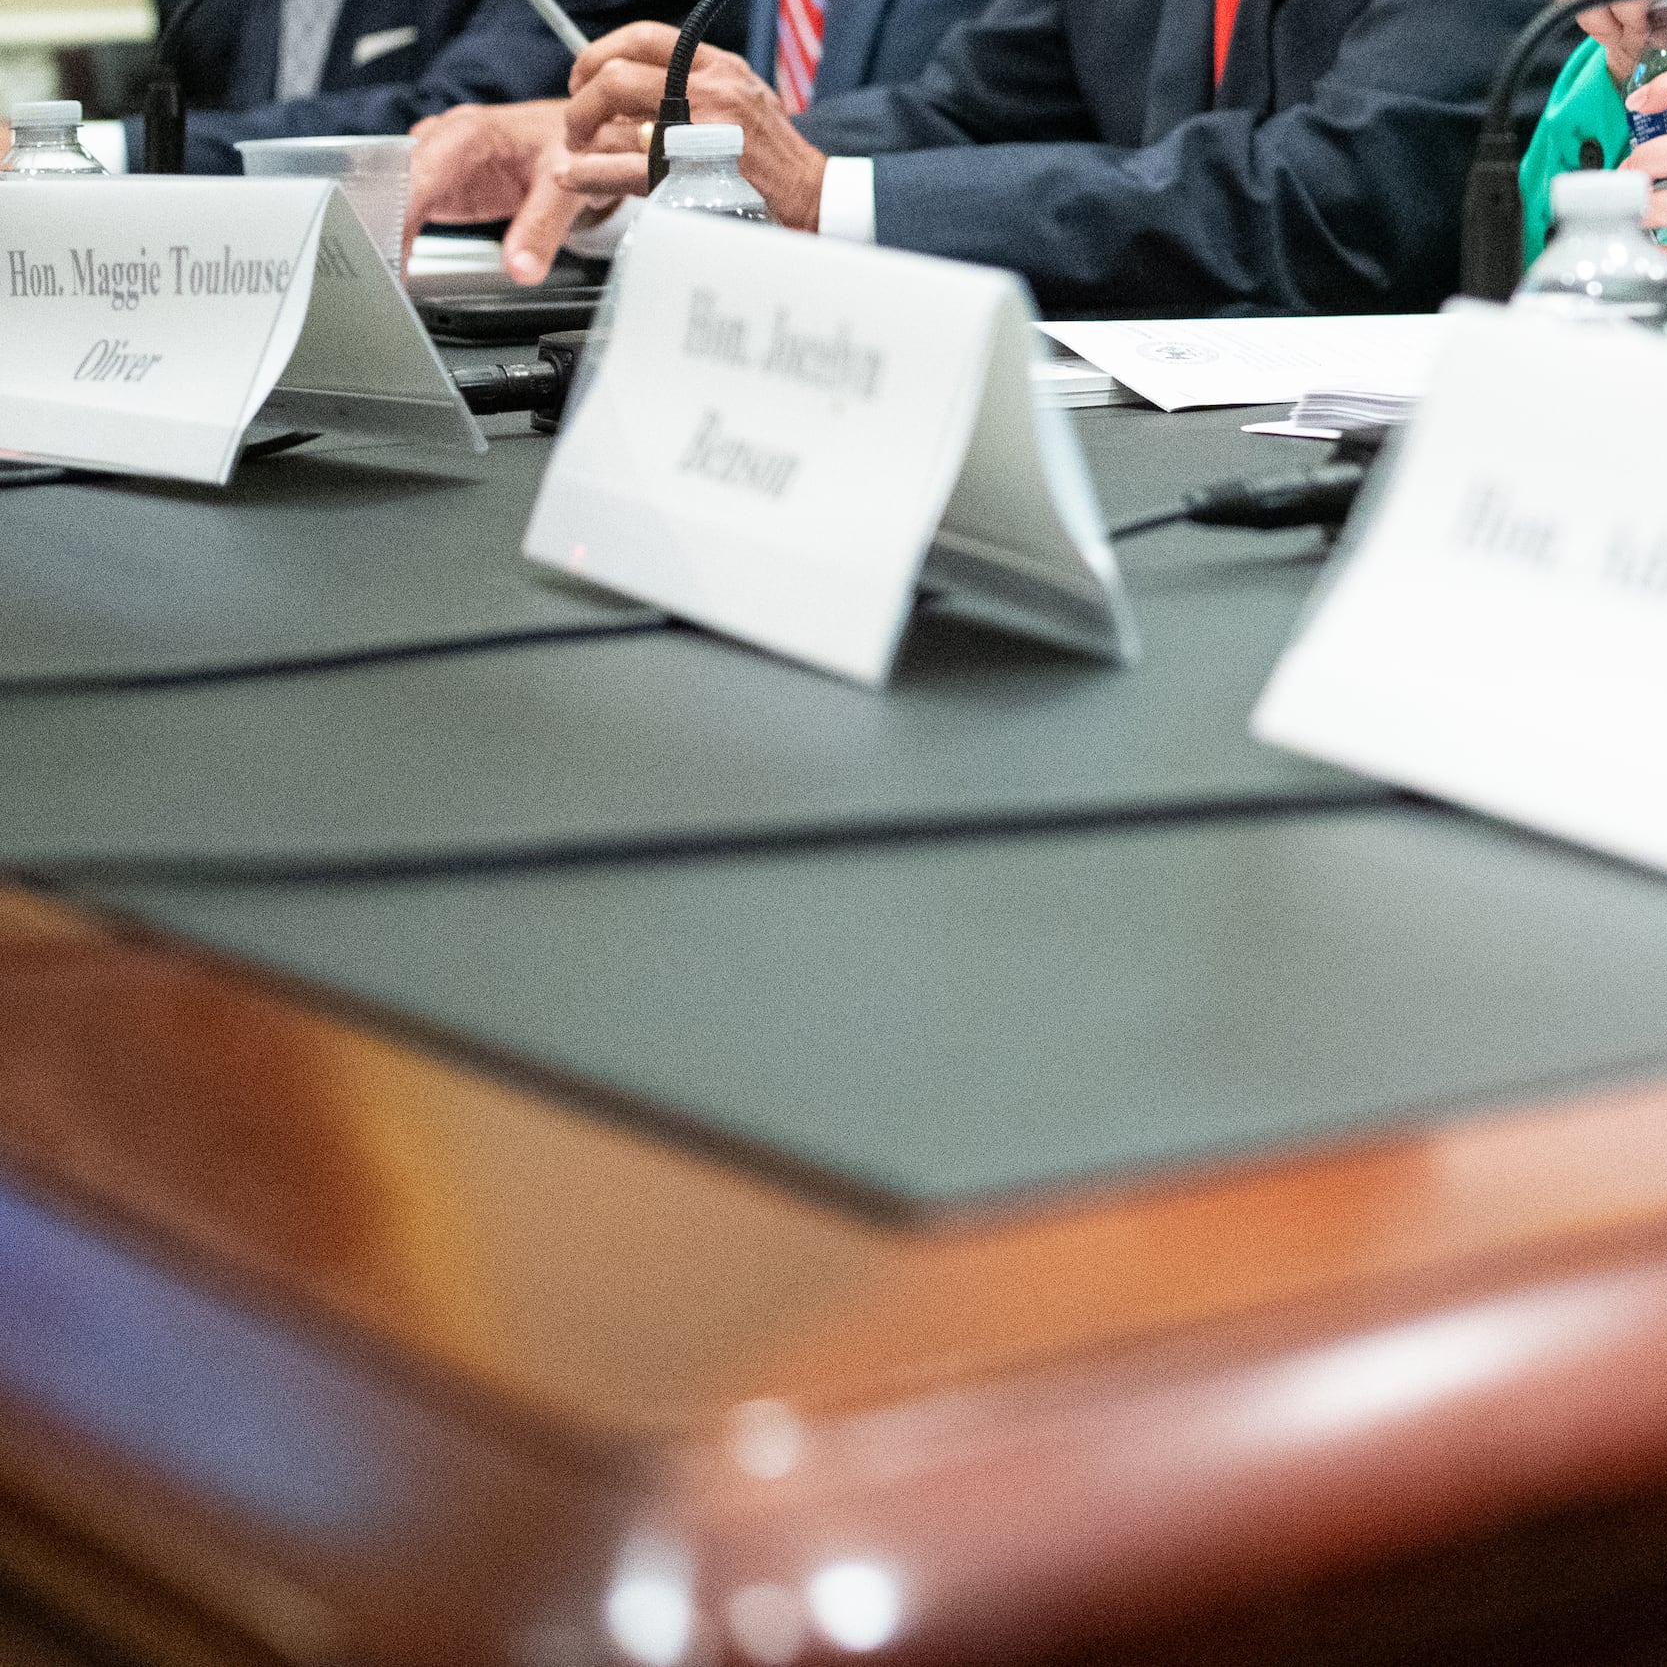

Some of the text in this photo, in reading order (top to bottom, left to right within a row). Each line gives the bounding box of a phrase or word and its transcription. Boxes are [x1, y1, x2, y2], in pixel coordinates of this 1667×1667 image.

[7, 249, 64, 298] Hon.
[70, 247, 162, 311] Maggie
[169, 245, 291, 297] Toulouse
[73, 338, 163, 383] Oliver
